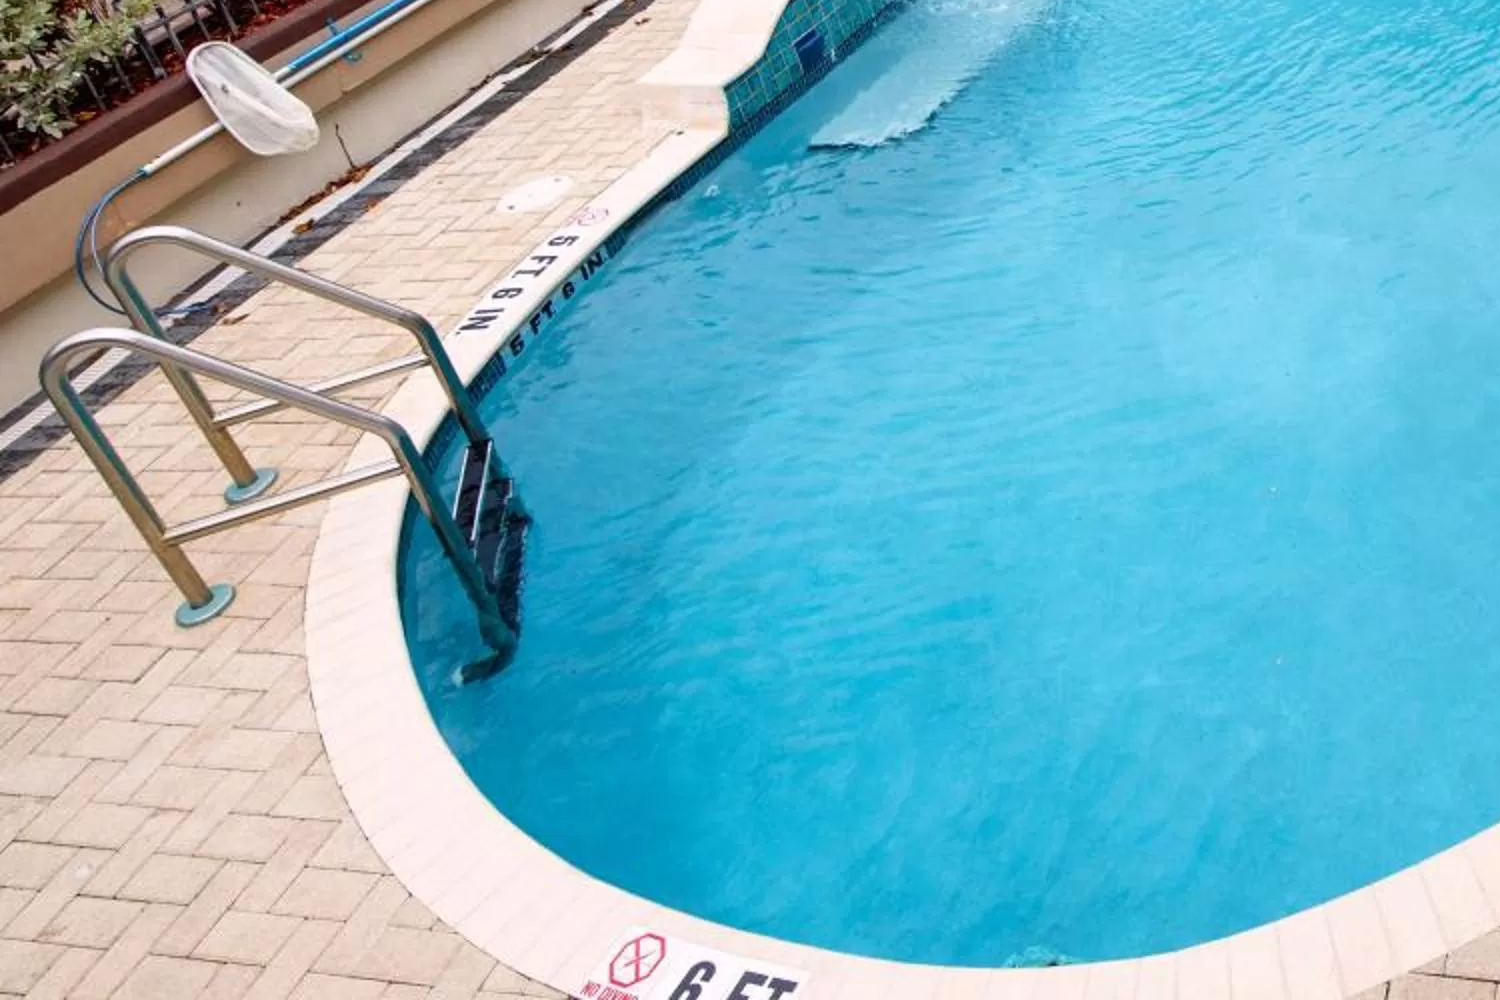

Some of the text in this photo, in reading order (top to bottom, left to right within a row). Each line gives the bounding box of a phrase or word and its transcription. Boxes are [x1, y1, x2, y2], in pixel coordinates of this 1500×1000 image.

[547, 235, 580, 247] 5
[491, 287, 524, 299] 6
[562, 281, 576, 300] 6
[669, 961, 716, 1000] 6
